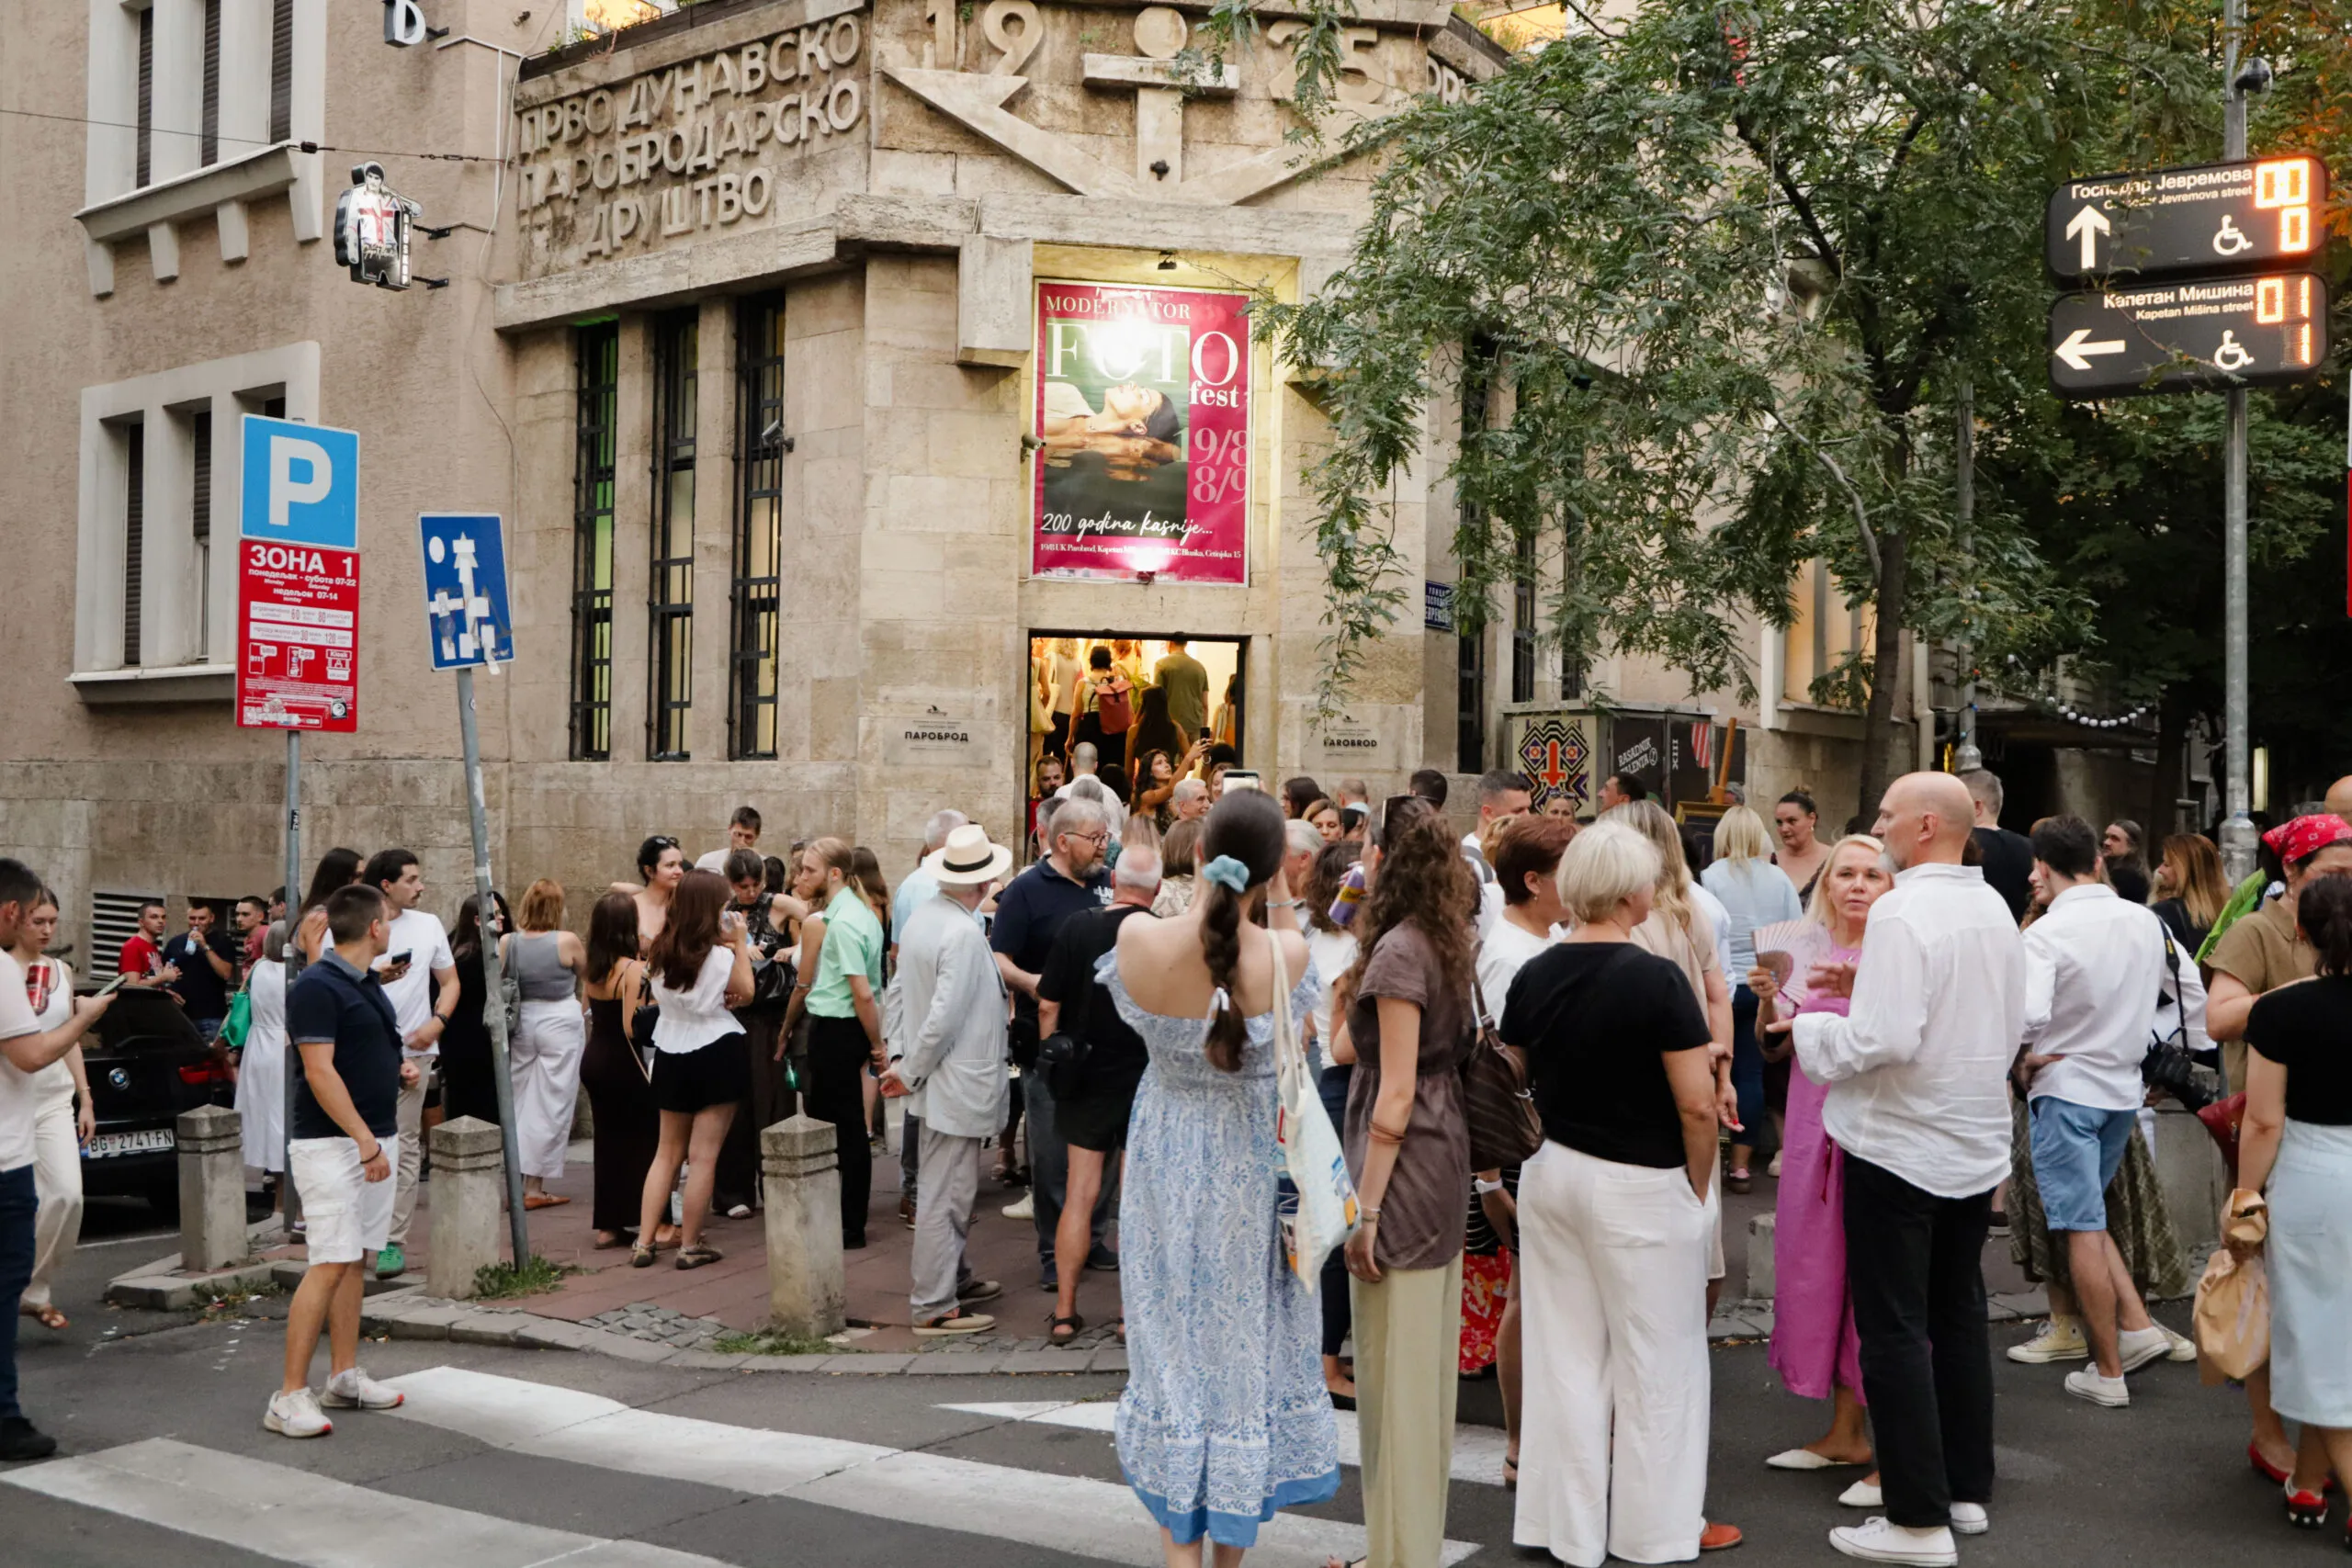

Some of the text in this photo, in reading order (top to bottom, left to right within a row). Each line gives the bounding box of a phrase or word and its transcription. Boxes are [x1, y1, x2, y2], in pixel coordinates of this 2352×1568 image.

[521, 14, 862, 156] ПРВО ДУНАВСКО
[519, 79, 864, 214] ПАРОБРОДАРСКО
[2155, 167, 2253, 194] Јевремова
[2158, 188, 2220, 204] Jevremova
[2221, 186, 2253, 198] street
[581, 166, 773, 264] ДРУШТВО
[2102, 282, 2254, 309] Капетан Мишина
[2135, 299, 2254, 321] Kapetan Mišina street
[1189, 380, 1240, 409] fest
[269, 434, 333, 526] P
[1040, 513, 1072, 533] 200
[1076, 511, 1136, 542] godina
[250, 544, 353, 578] ЗОНА 1
[248, 568, 298, 581] понедељак
[304, 574, 334, 585] субота
[334, 577, 356, 587] 07-22
[904, 731, 969, 742] ПАРОБРОД
[1618, 736, 1652, 767] RASADNIK
[90, 1136, 107, 1152] BG
